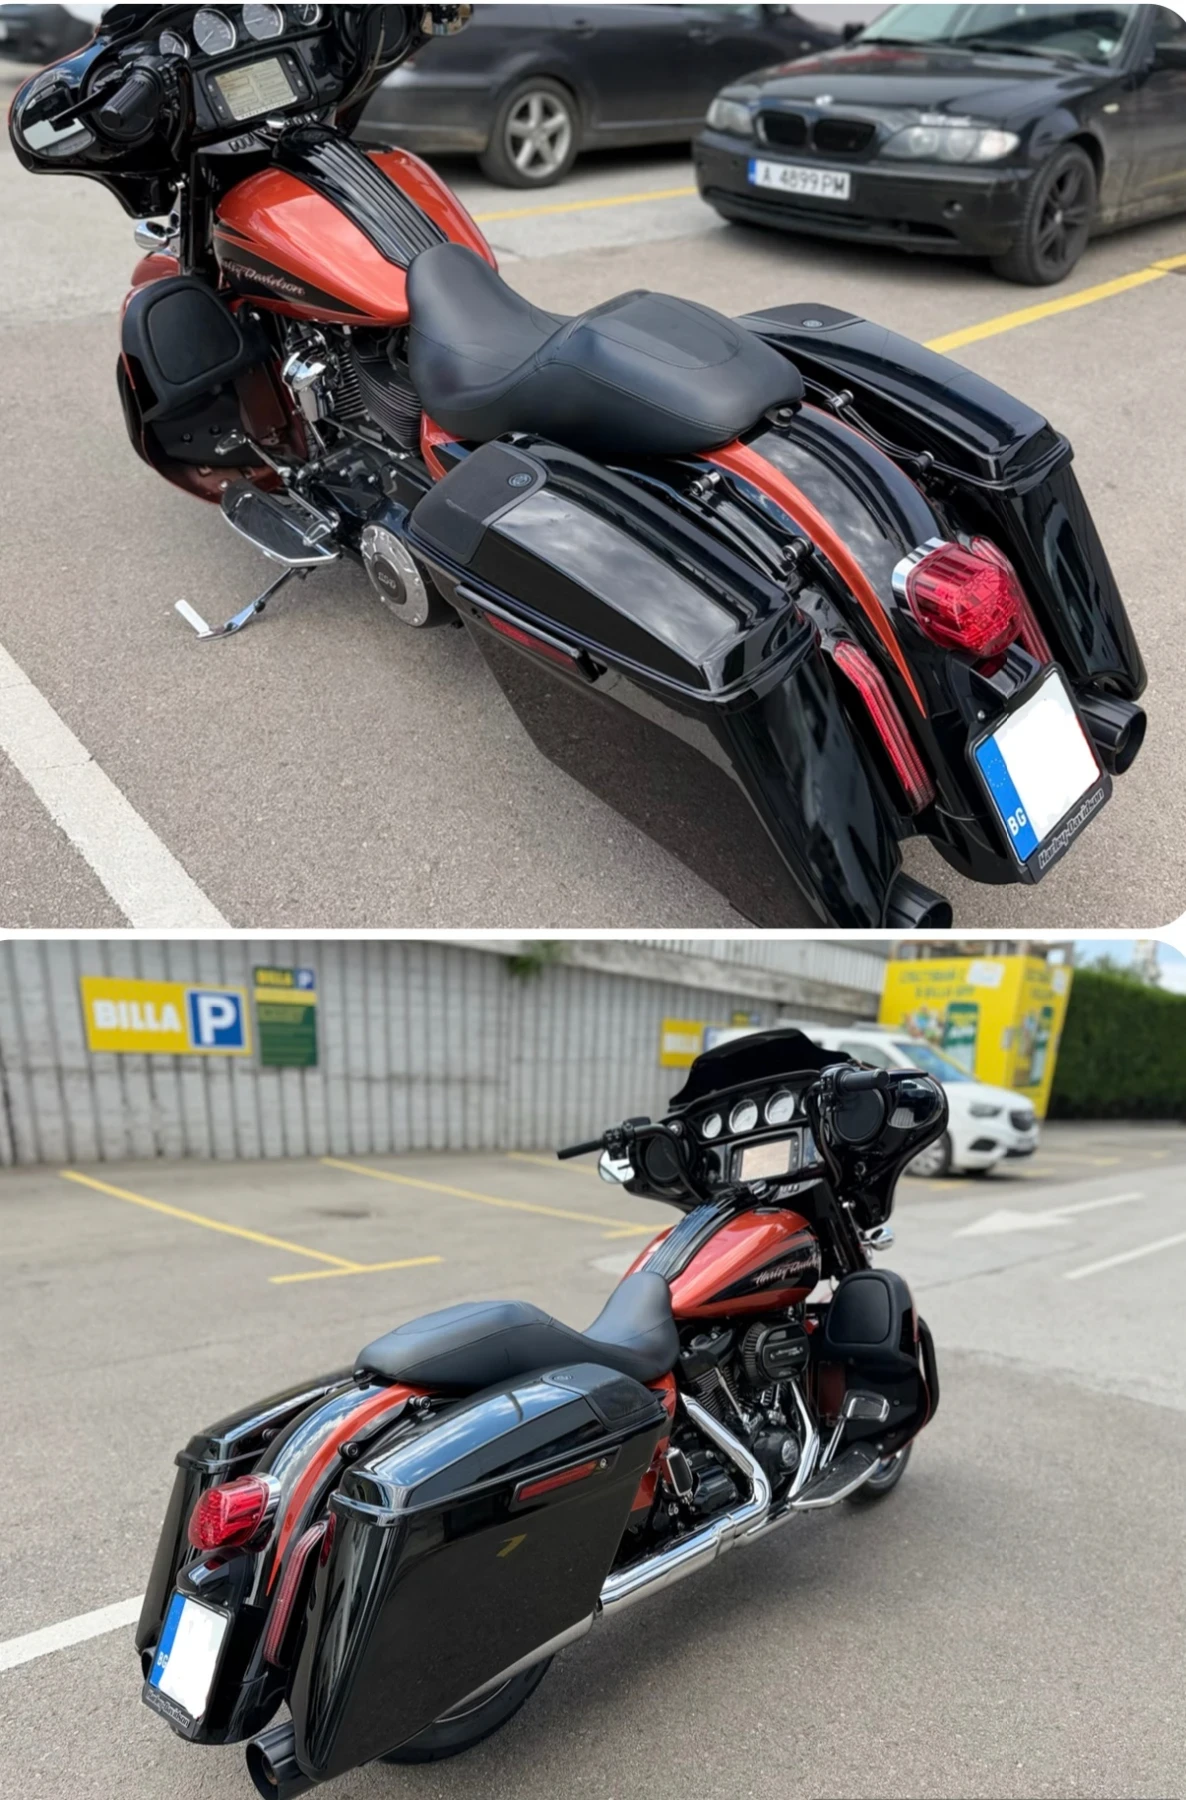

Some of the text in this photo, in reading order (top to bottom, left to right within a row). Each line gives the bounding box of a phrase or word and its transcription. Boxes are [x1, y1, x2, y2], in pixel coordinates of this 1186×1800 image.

[1007, 807, 1027, 837] BG
[1037, 787, 1105, 870] Harley-Davidson
[92, 999, 182, 1033] BILLA
[197, 995, 237, 1046] P
[145, 1688, 190, 1729] Harley-Davidson
